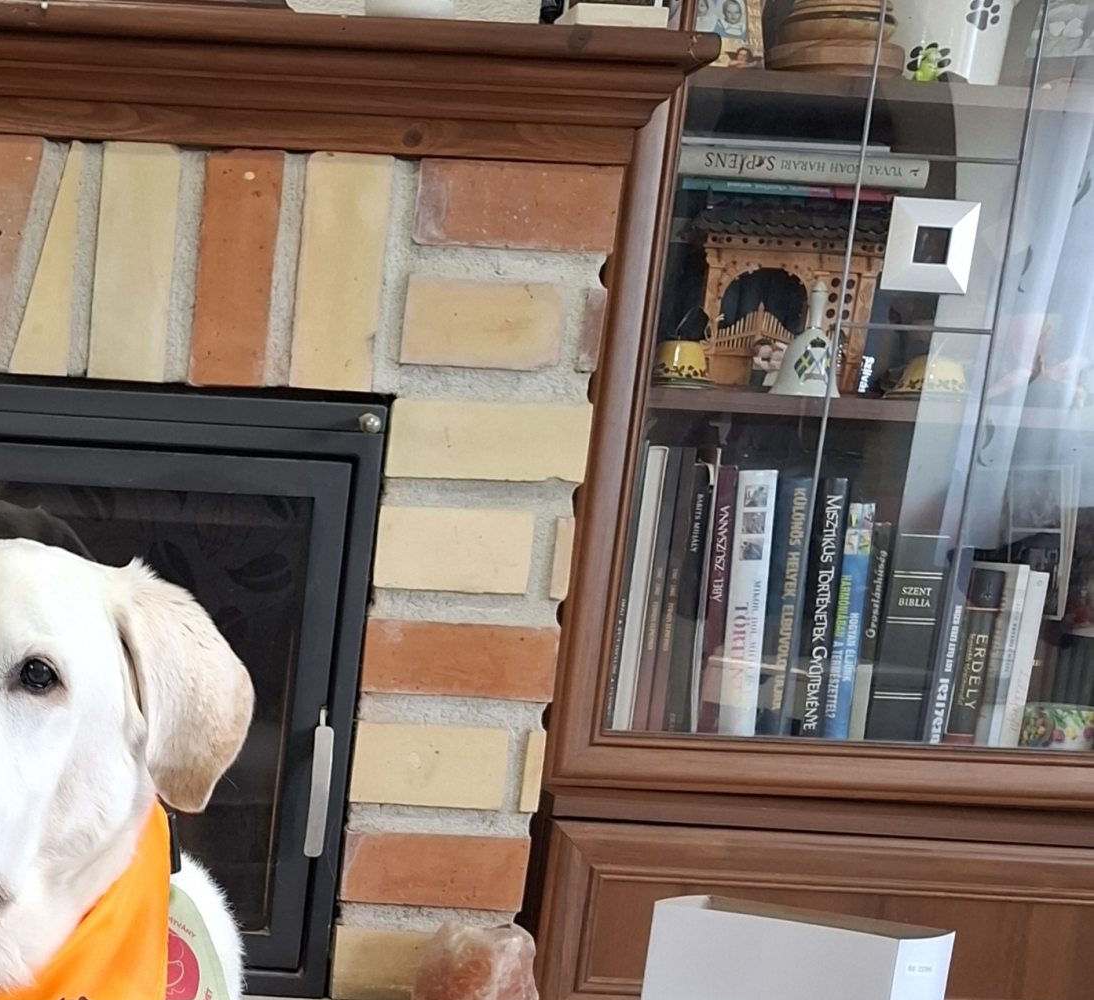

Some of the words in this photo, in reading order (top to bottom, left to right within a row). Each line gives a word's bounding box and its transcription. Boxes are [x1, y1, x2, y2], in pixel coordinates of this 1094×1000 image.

[705, 151, 776, 175] SAPIENS
[780, 159, 825, 173] HARARI
[830, 163, 861, 174] OAH
[866, 165, 903, 177] YUVAL
[789, 487, 807, 547] KÜLÖNÖS
[901, 586, 933, 596] SZENT
[898, 597, 931, 608] BIBLIA
[847, 612, 860, 645] HOGYAN
